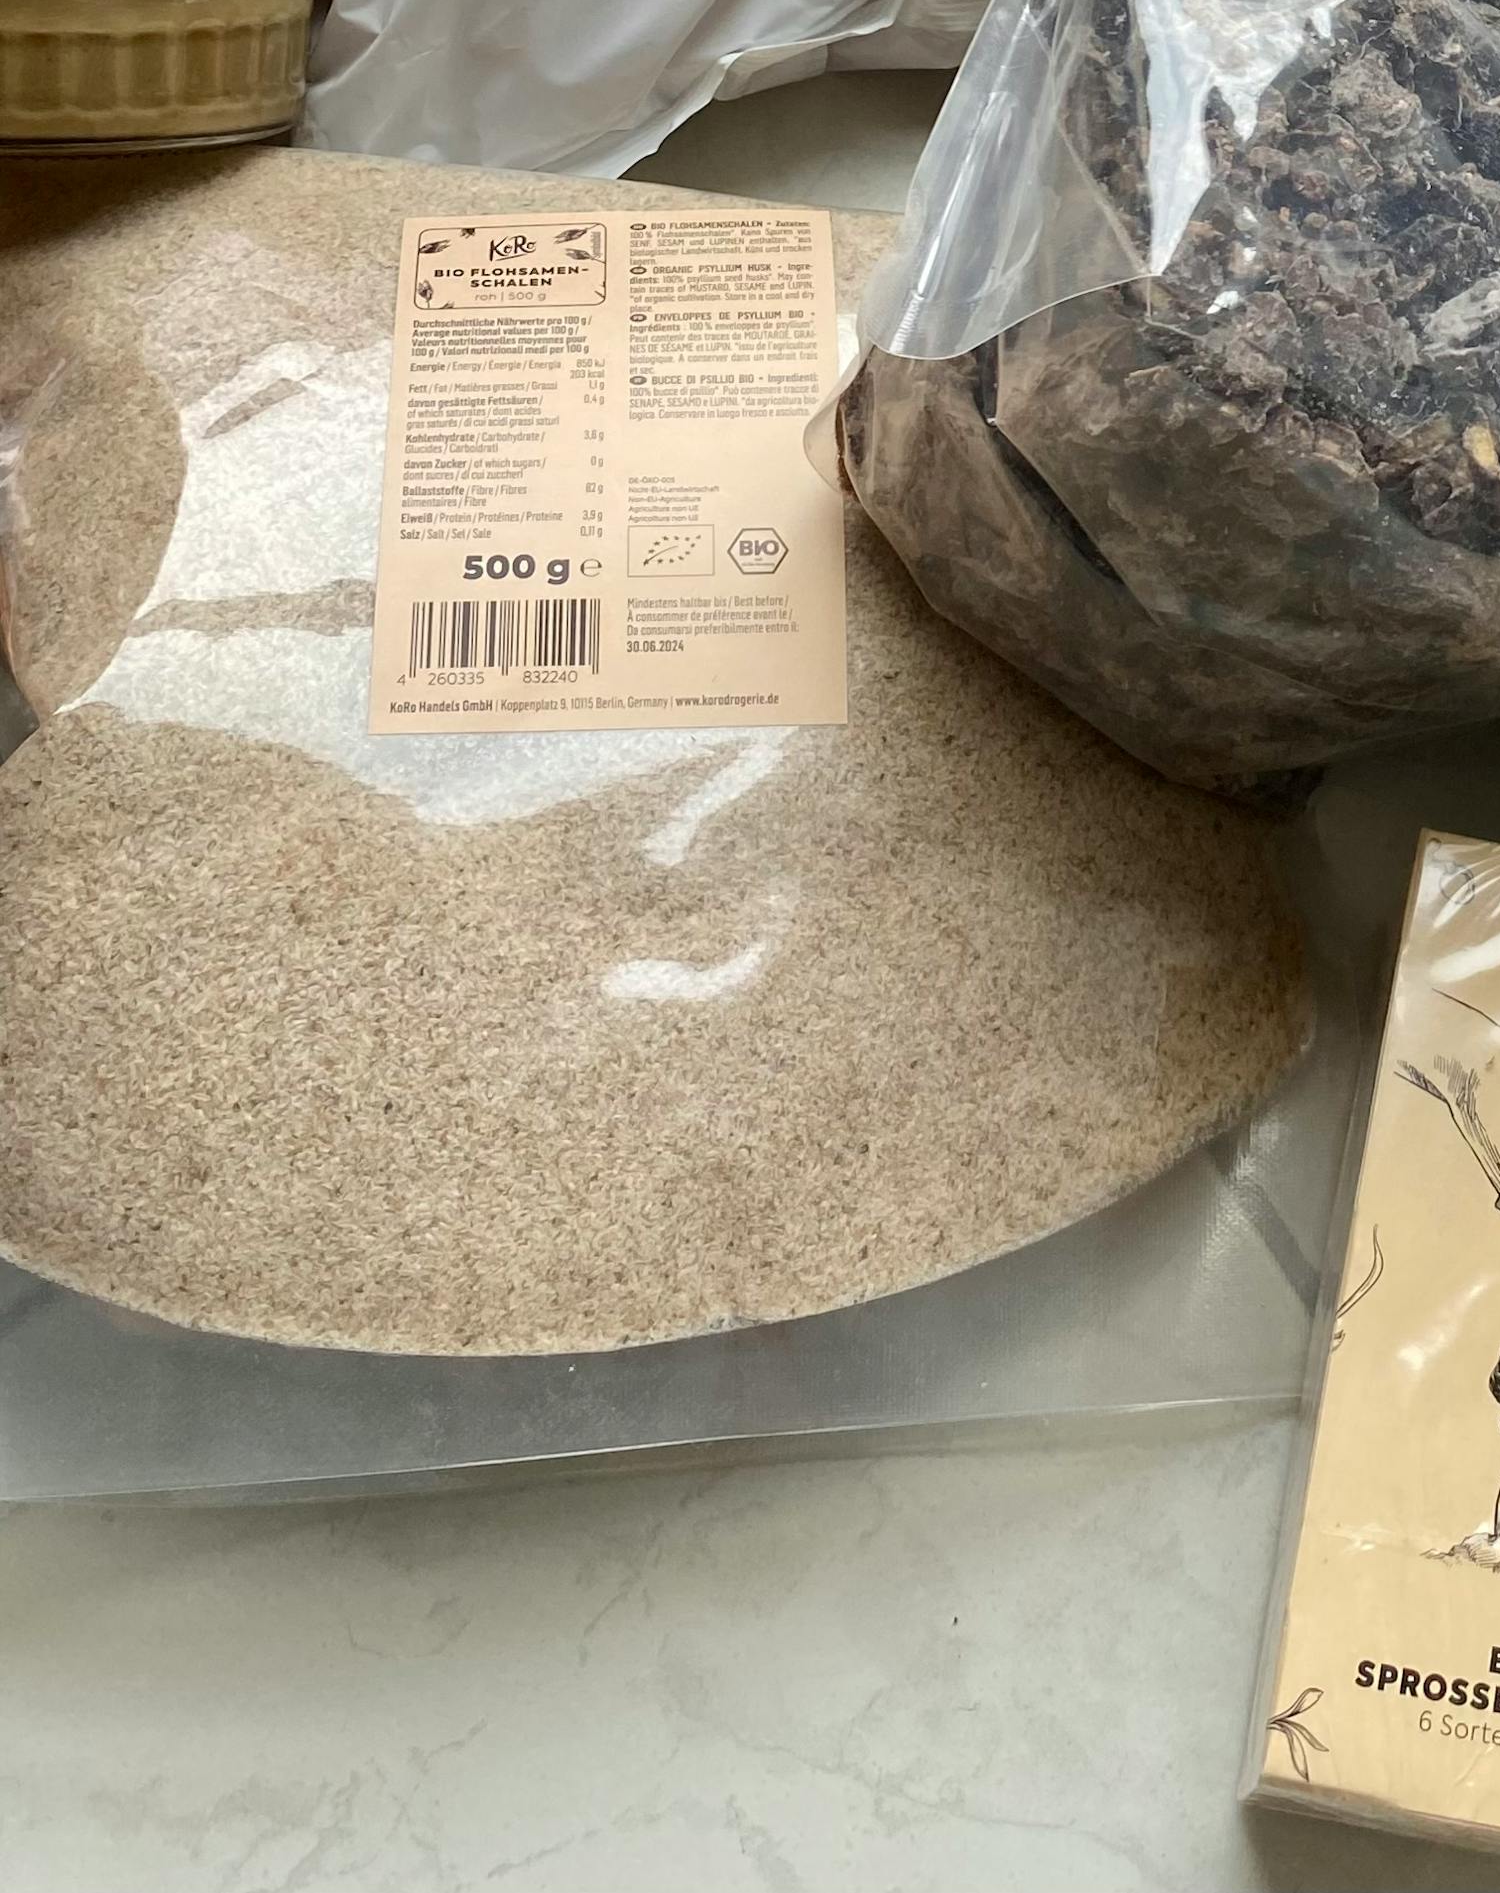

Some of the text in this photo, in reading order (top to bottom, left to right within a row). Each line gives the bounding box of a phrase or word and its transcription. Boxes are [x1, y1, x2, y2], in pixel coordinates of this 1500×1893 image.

[489, 235, 537, 261] KoRo
[434, 266, 589, 277] BIO FLOHSAMEN-
[470, 278, 552, 287] SCHALEN
[475, 292, 497, 301] roh
[508, 292, 533, 301] 500
[413, 317, 546, 329] Durchschnittliche Nährwerte
[410, 362, 445, 372] Energie
[403, 486, 465, 497] Ballaststoffe
[739, 540, 779, 557] BIO
[463, 554, 570, 585] 500 g
[627, 640, 684, 653] 30.06.2024
[396, 669, 579, 686] 4 260335 832240
[390, 693, 780, 713] KoRo Handels GmbH Koppenplatz Germany www.korodrogerie.de
[1418, 1710, 1433, 1732] 6
